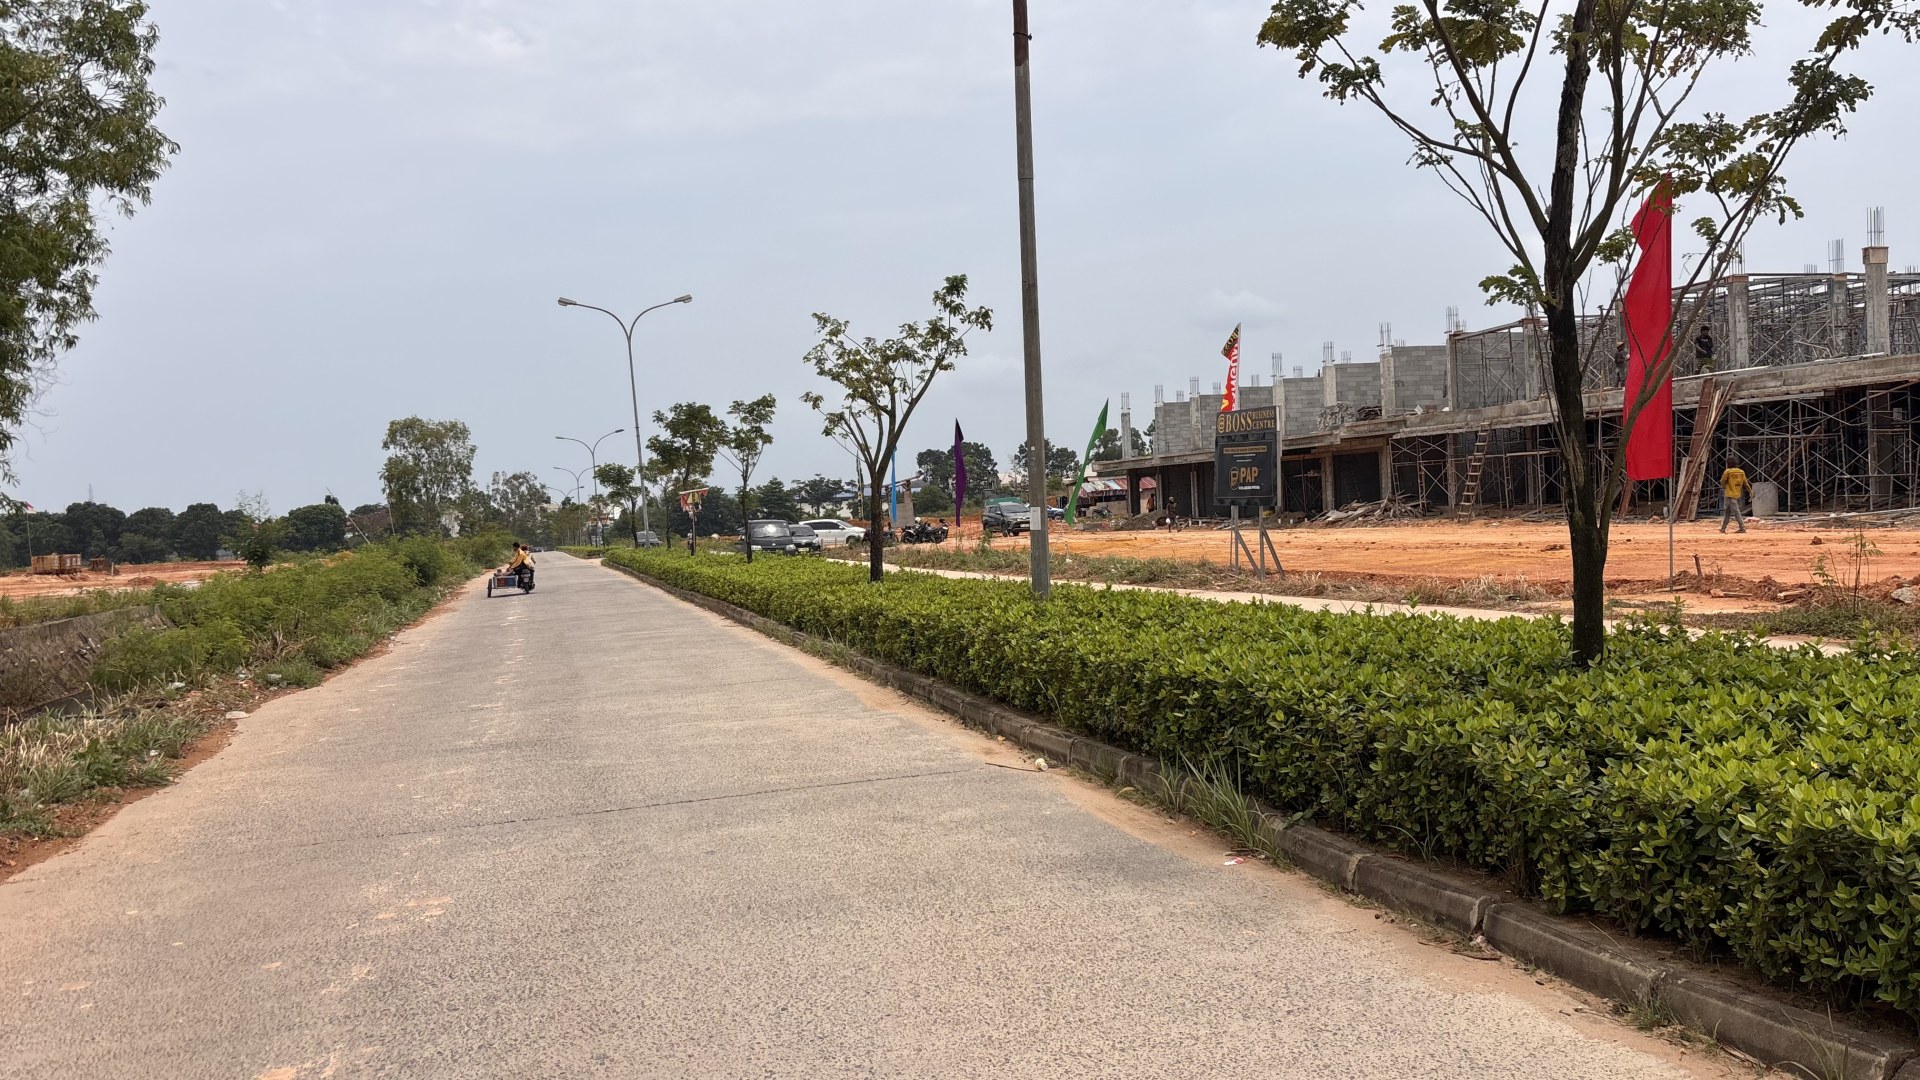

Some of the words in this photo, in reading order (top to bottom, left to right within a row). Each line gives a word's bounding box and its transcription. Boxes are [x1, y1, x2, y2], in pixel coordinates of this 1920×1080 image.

[1252, 409, 1275, 420] BUSINESS
[1252, 419, 1275, 430] CENTRE
[1240, 466, 1259, 483] PAP
